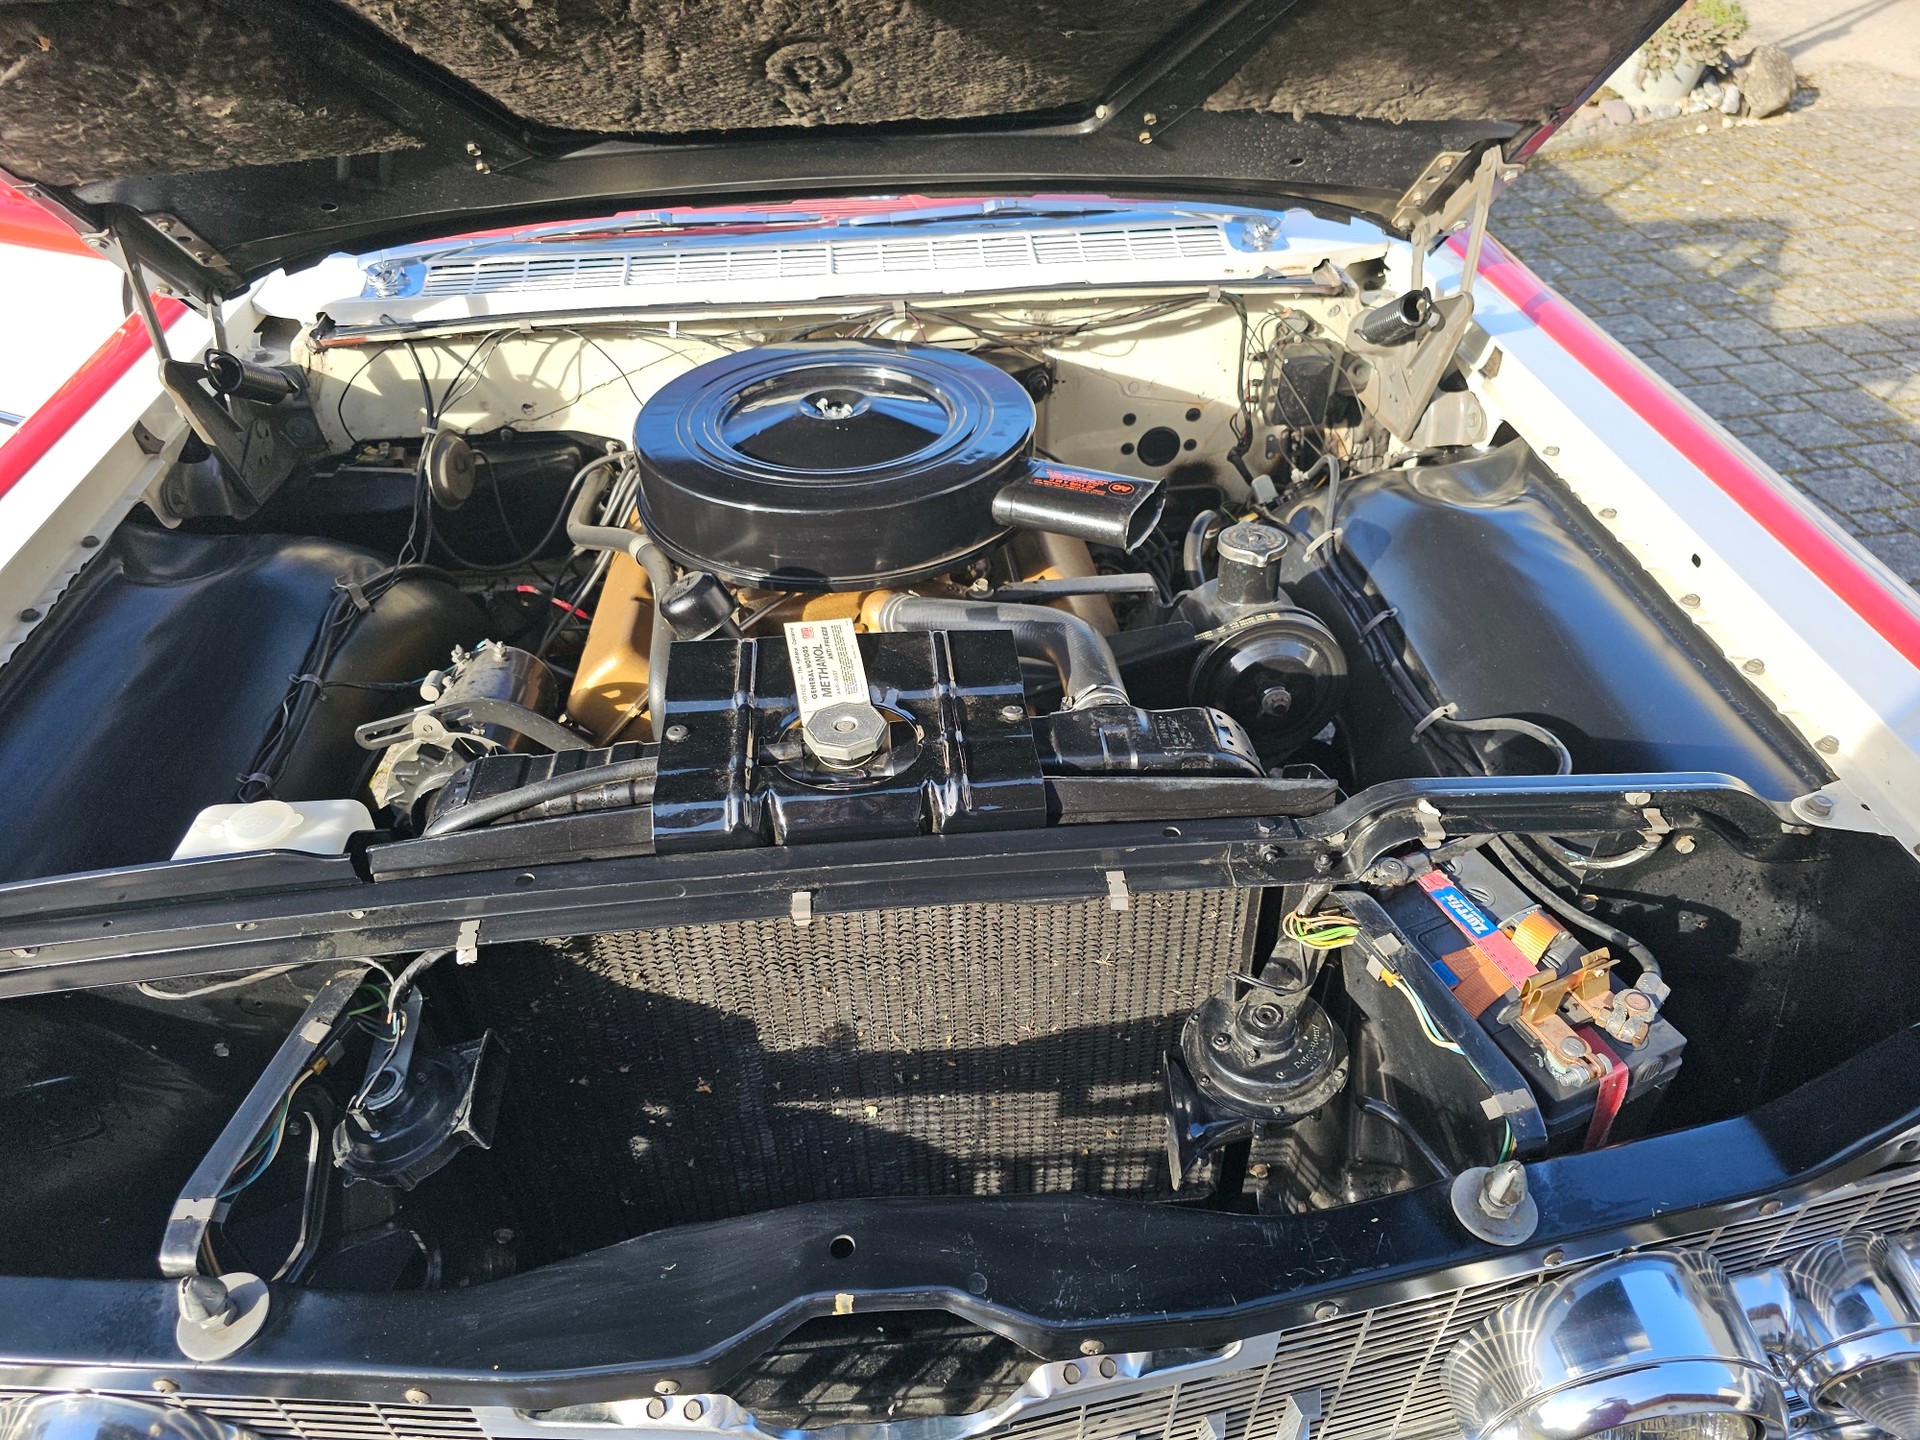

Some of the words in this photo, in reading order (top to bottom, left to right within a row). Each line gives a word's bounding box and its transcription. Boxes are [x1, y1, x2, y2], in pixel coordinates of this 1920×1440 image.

[802, 645, 812, 669] MOTORS
[820, 625, 833, 660] ANTI-FREEZE
[807, 669, 818, 699] GENERAL
[812, 643, 832, 698] METHANOL
[800, 684, 808, 704] NOTICE
